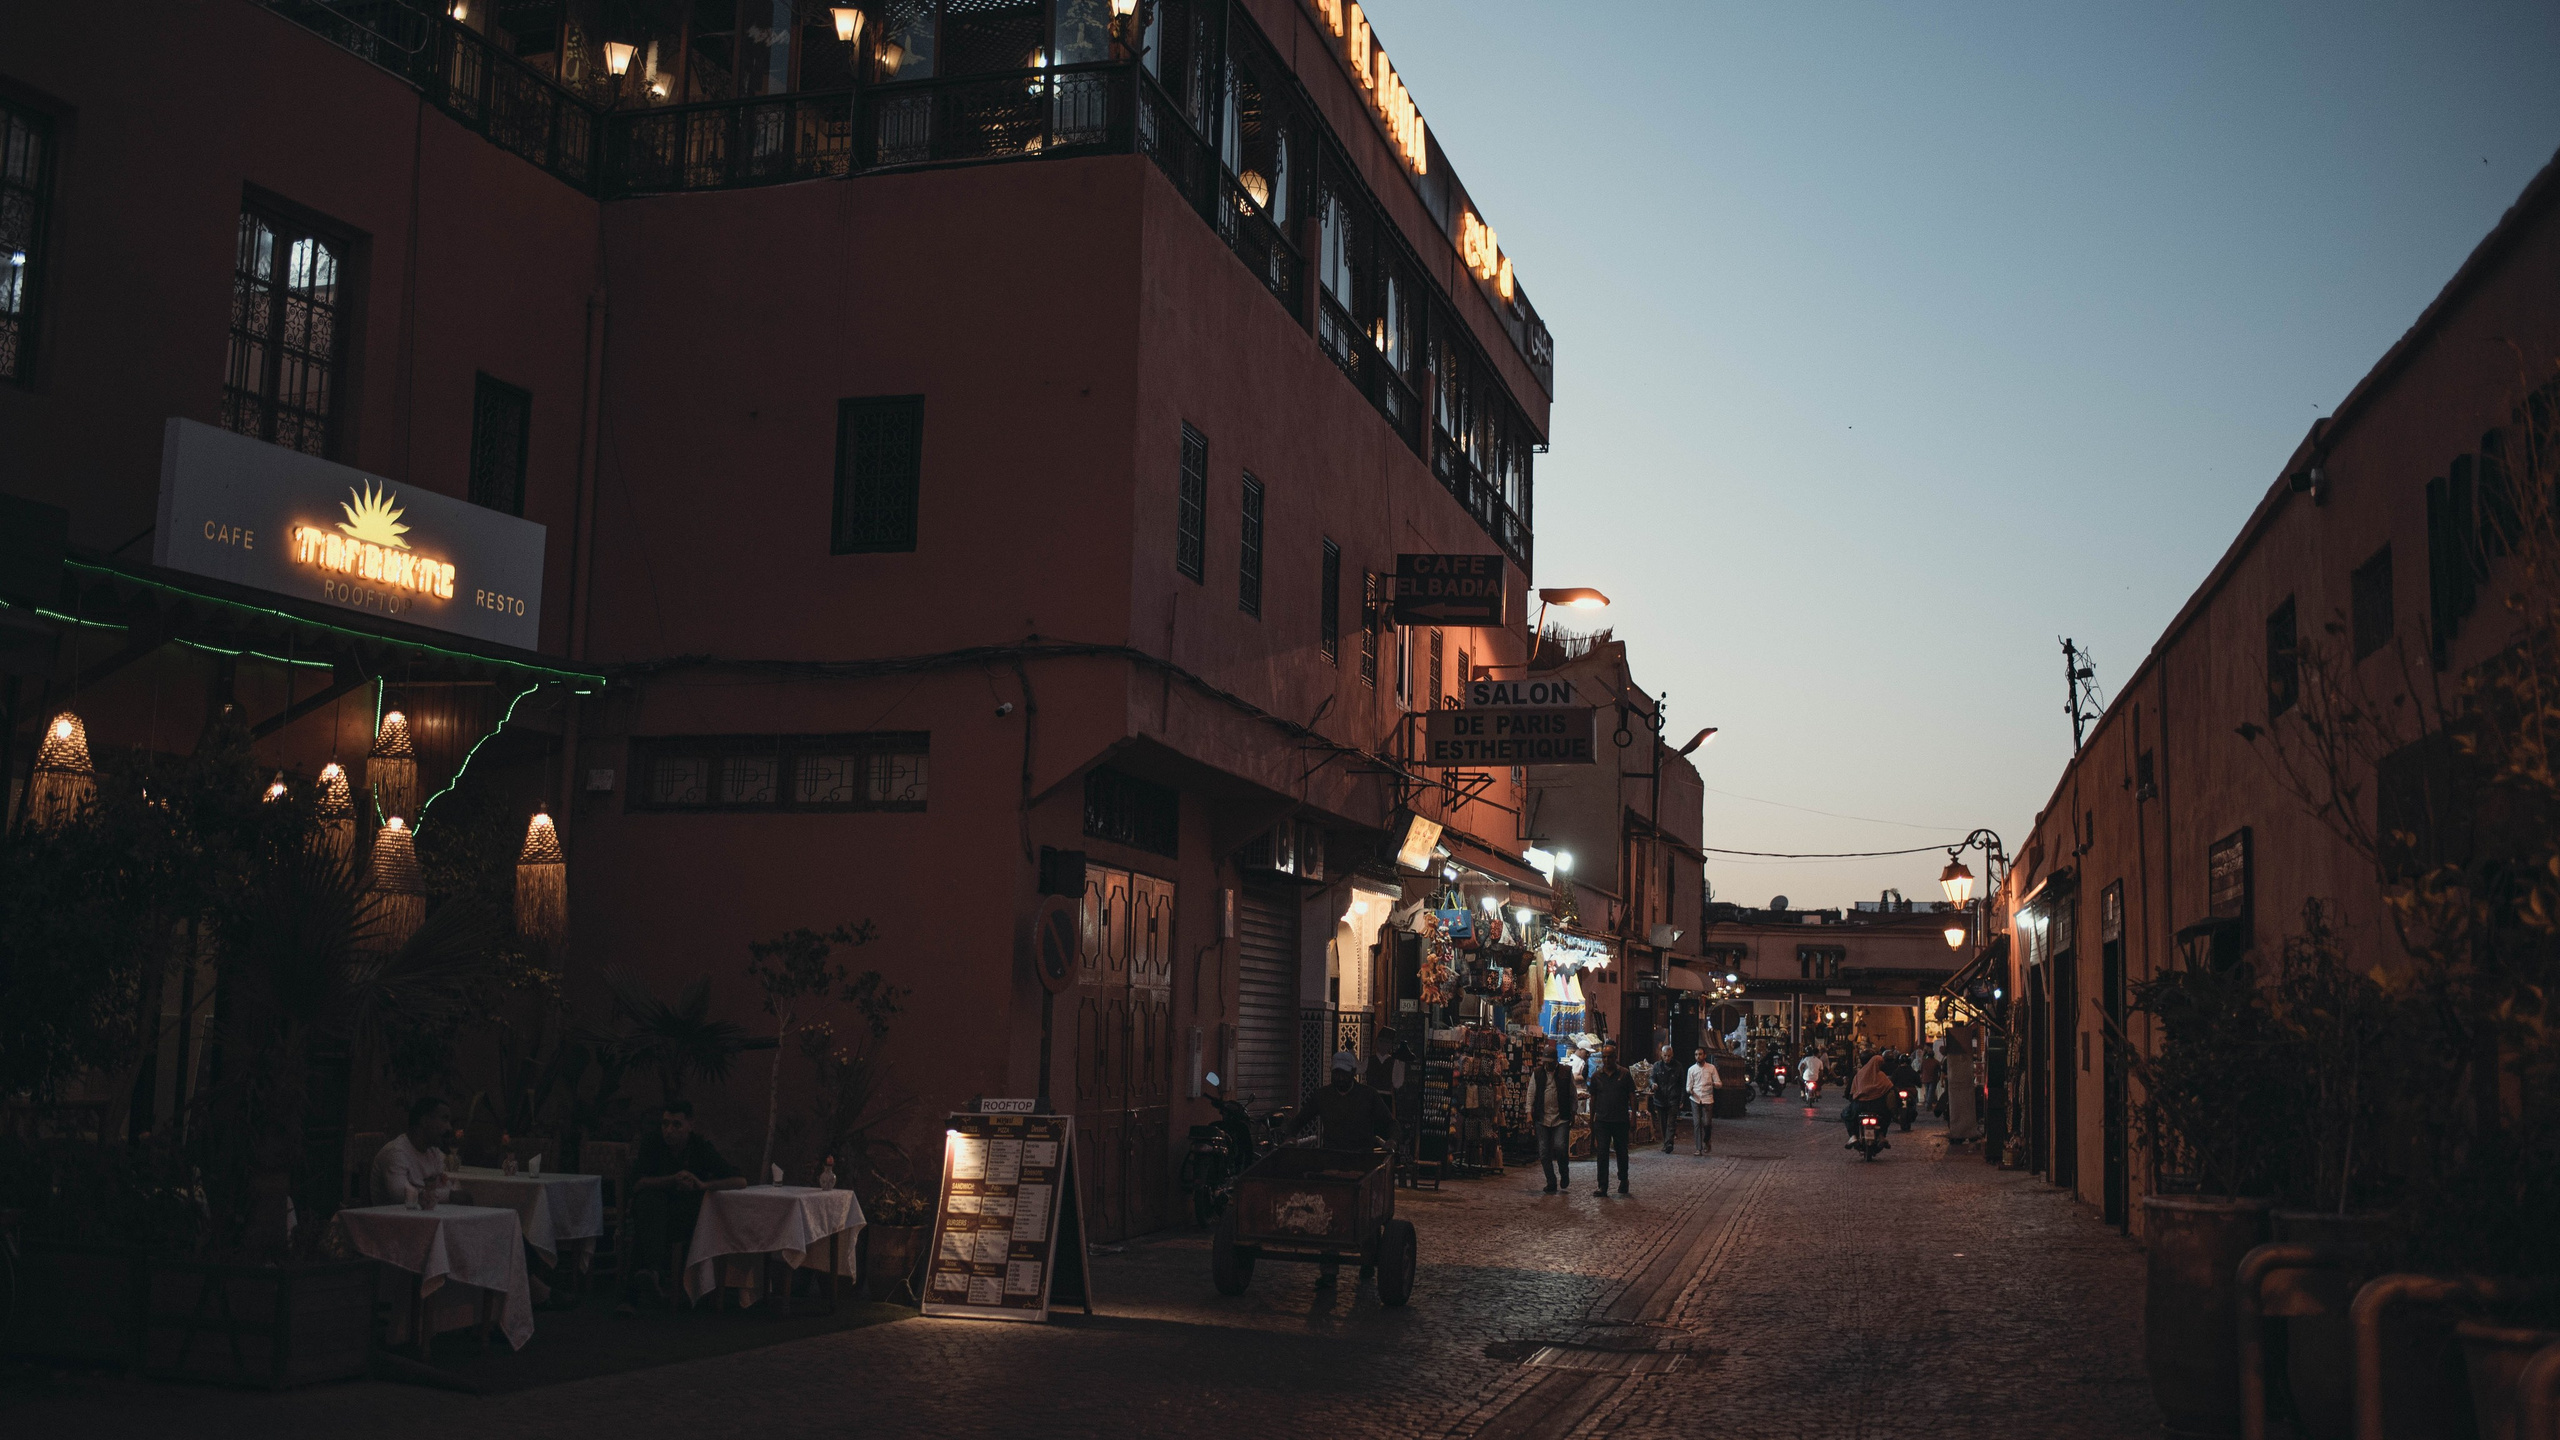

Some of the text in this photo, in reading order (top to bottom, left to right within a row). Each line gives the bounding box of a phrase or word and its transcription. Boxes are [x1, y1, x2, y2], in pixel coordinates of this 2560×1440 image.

[204, 520, 255, 550] CAFE
[1413, 555, 1486, 575] CAFE
[324, 579, 413, 616] ROOFTOP
[1400, 578, 1500, 598] EL BADIA
[476, 588, 525, 617] RESTO
[1473, 682, 1571, 706] SALON
[1454, 714, 1567, 735] DE PARIS
[1434, 738, 1587, 760] ESTHETIQUE
[983, 1101, 1033, 1111] ROOFTOP
